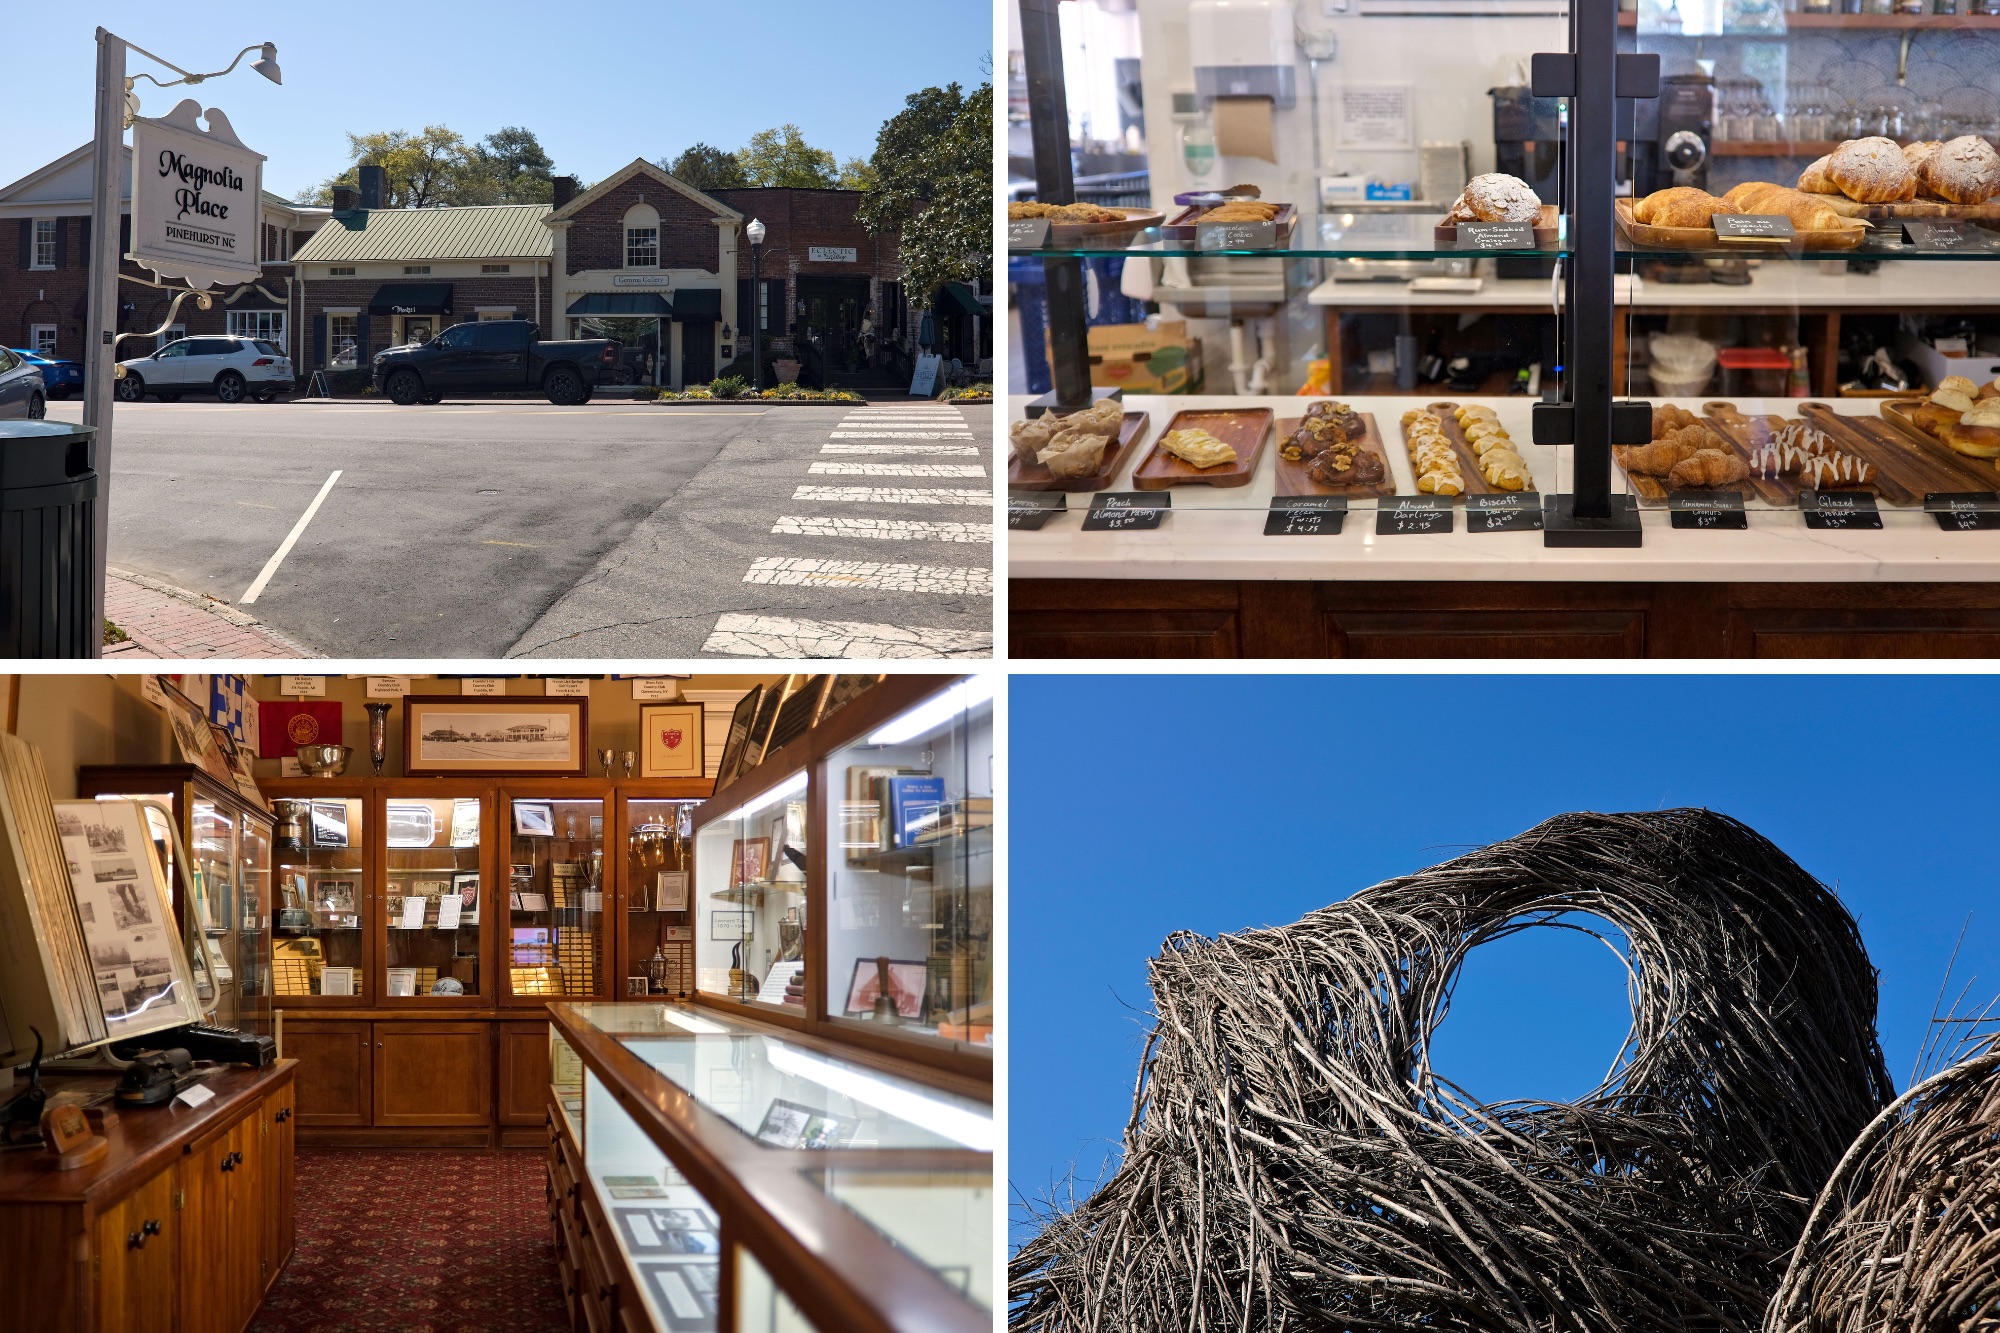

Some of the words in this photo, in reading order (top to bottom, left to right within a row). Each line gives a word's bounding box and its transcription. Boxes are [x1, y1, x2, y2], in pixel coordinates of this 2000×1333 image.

[159, 151, 243, 191] Magnolia
[175, 188, 229, 220] Place
[166, 226, 220, 246] PINEHURST
[222, 237, 236, 248] NC
[1106, 497, 1131, 507] Peach
[1285, 499, 1329, 508] Caramel
[1398, 501, 1435, 509] Almond
[1479, 495, 1518, 506] Biscoff
[1818, 495, 1855, 508] Glazed
[1950, 500, 1978, 511] Apple
[1129, 509, 1157, 520] Pastry
[1289, 516, 1322, 524] Twists
[1393, 510, 1443, 520] Darlings
[1950, 511, 1979, 519] Tart
